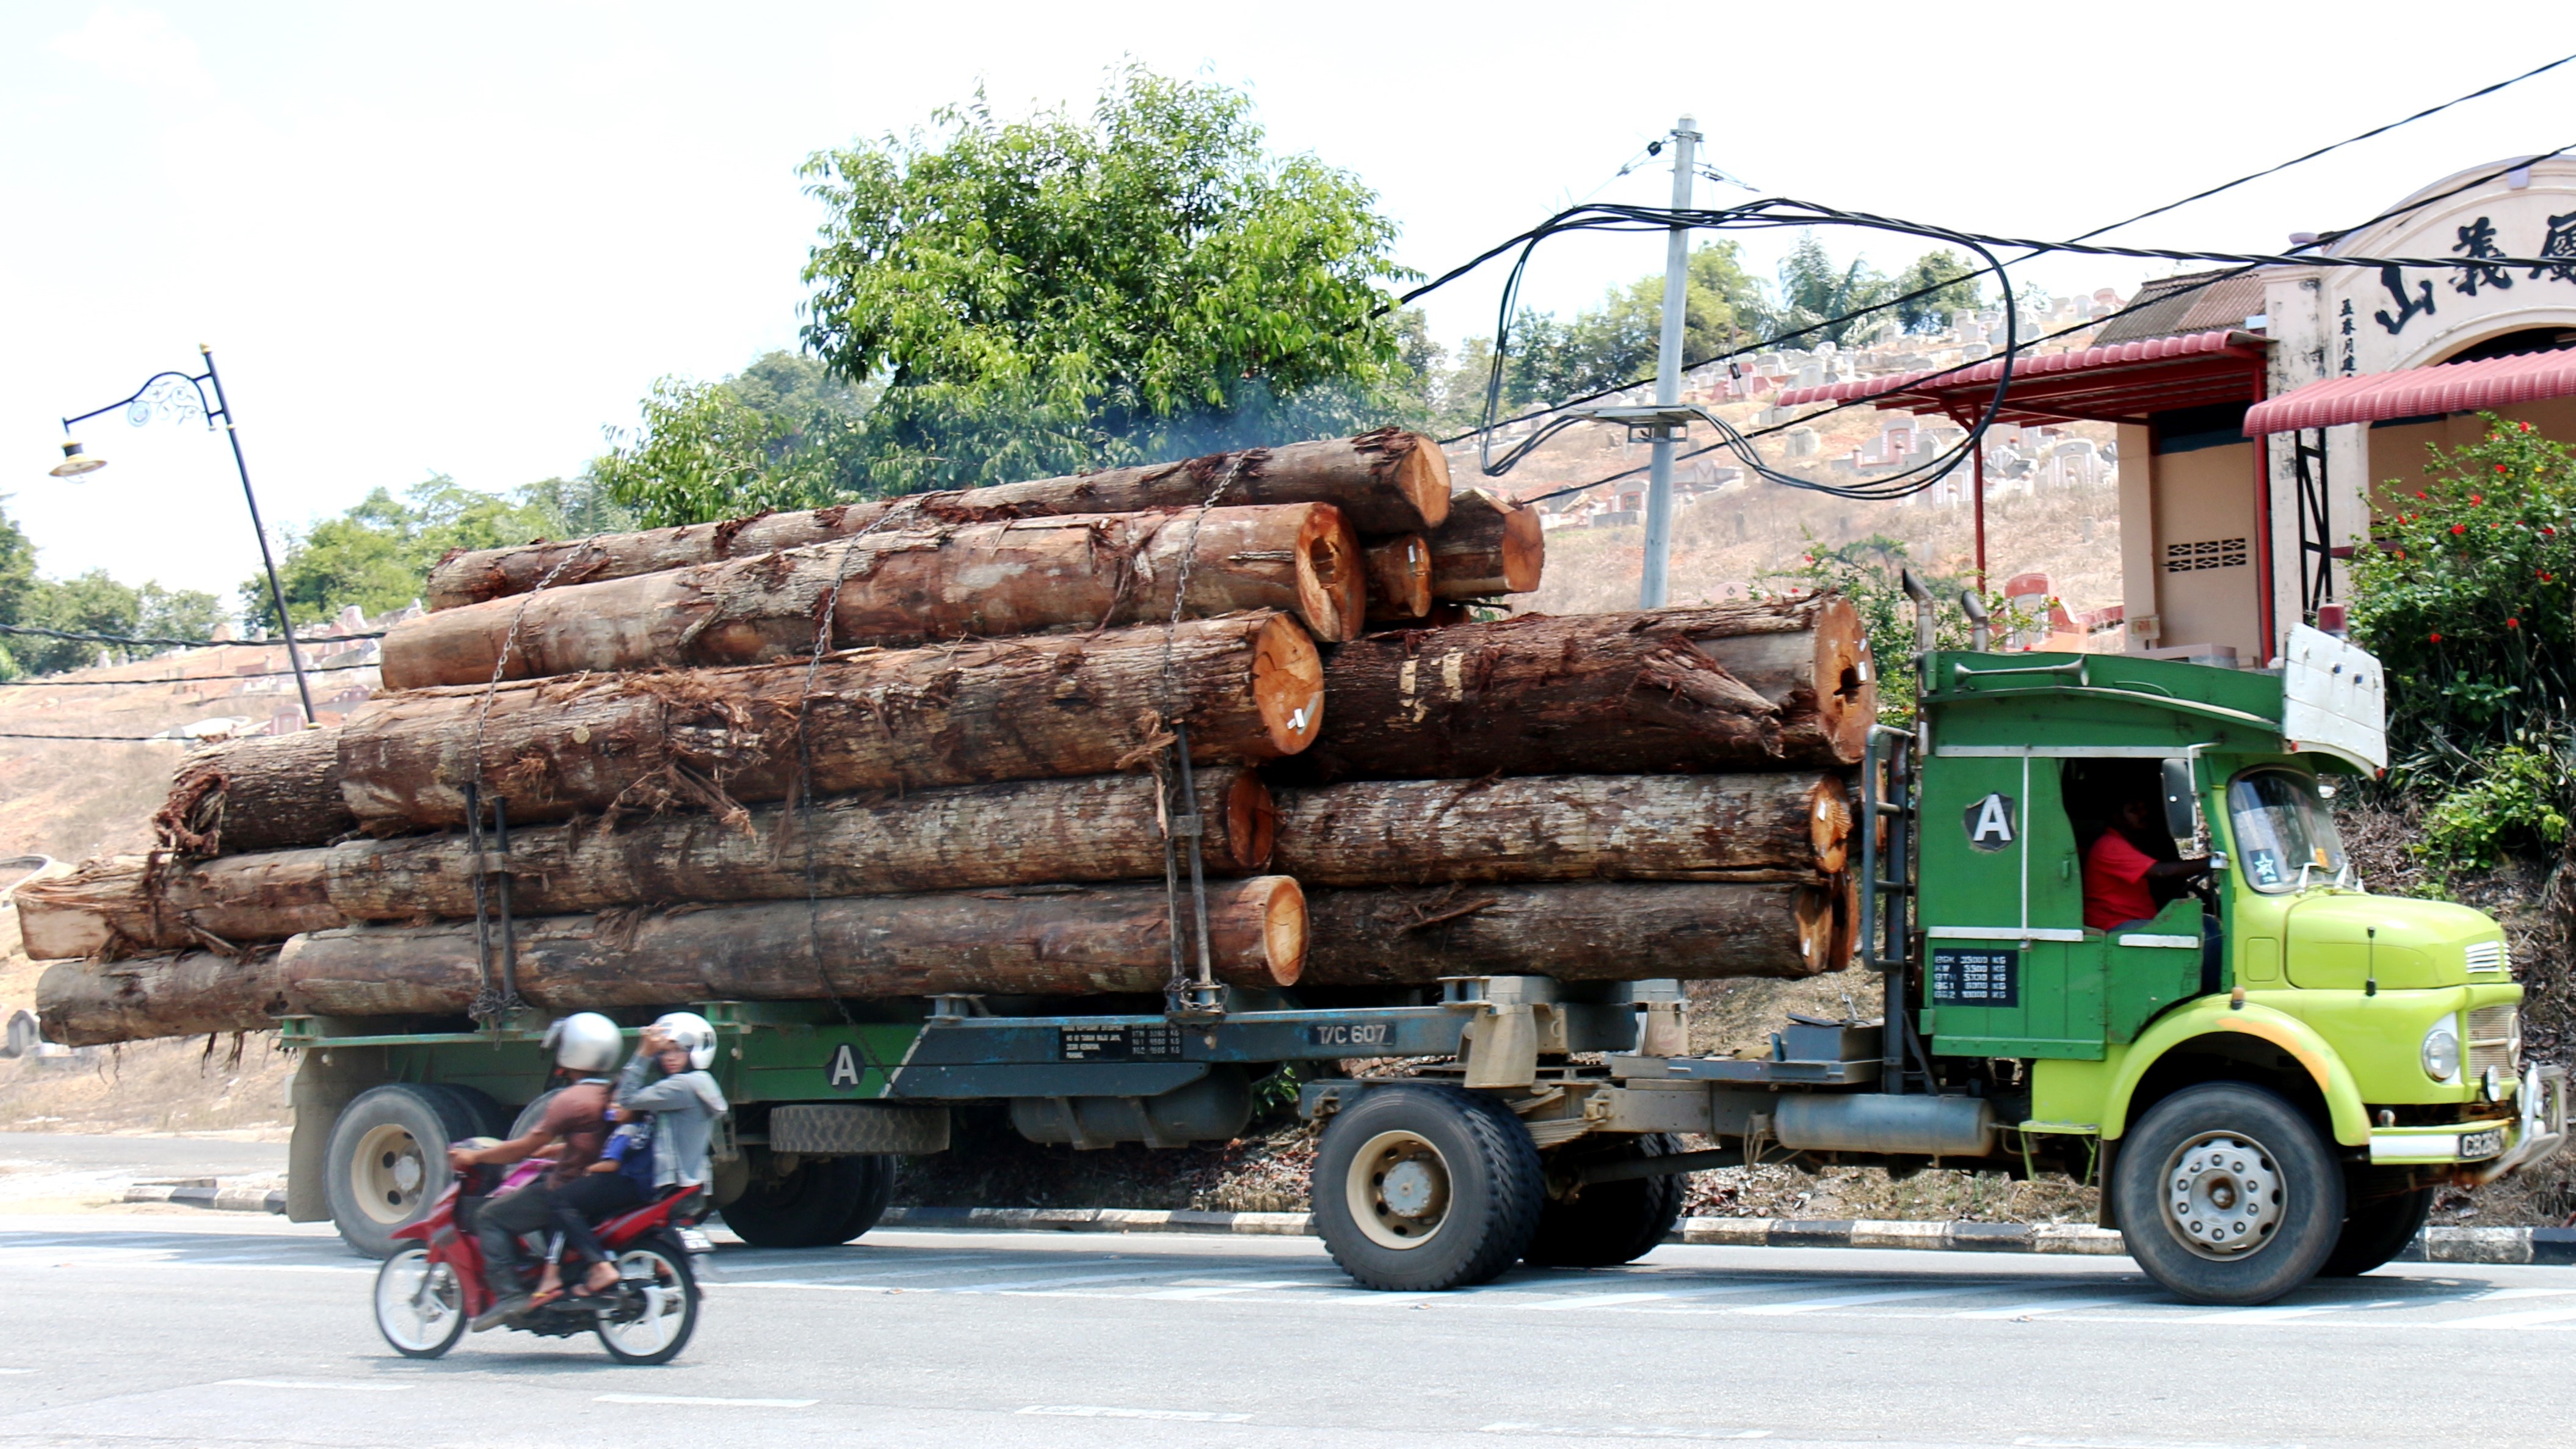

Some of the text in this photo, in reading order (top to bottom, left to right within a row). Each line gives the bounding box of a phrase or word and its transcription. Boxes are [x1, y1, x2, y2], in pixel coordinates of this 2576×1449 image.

[1973, 794, 2012, 841] A
[1316, 1024, 1387, 1044] T/C 607
[832, 1045, 858, 1085] A
